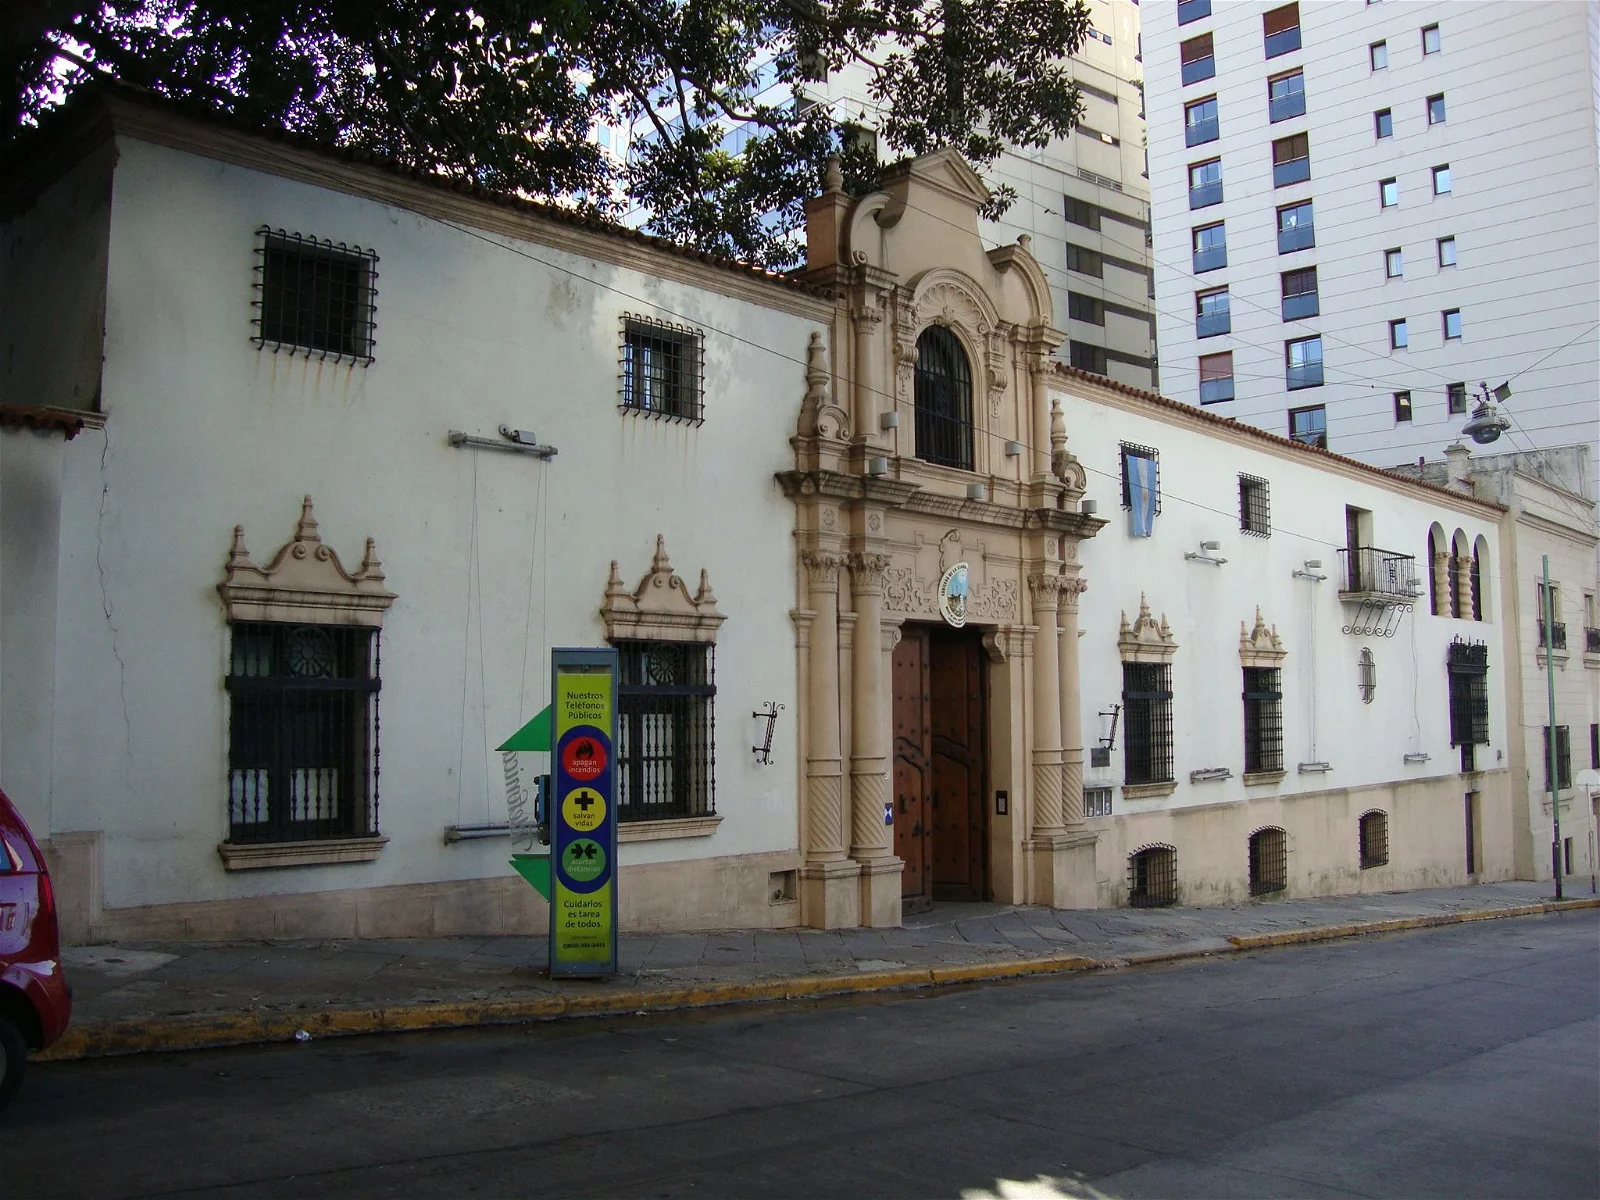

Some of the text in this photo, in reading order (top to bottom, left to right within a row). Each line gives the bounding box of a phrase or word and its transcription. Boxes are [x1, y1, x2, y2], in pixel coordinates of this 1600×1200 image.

[567, 692, 604, 700] Nuestros
[565, 701, 605, 709] Teléfonos
[568, 711, 602, 719] Públicos
[567, 865, 600, 873] distancias
[563, 900, 602, 908] Cuidarlos
[565, 920, 603, 928] de todos.
